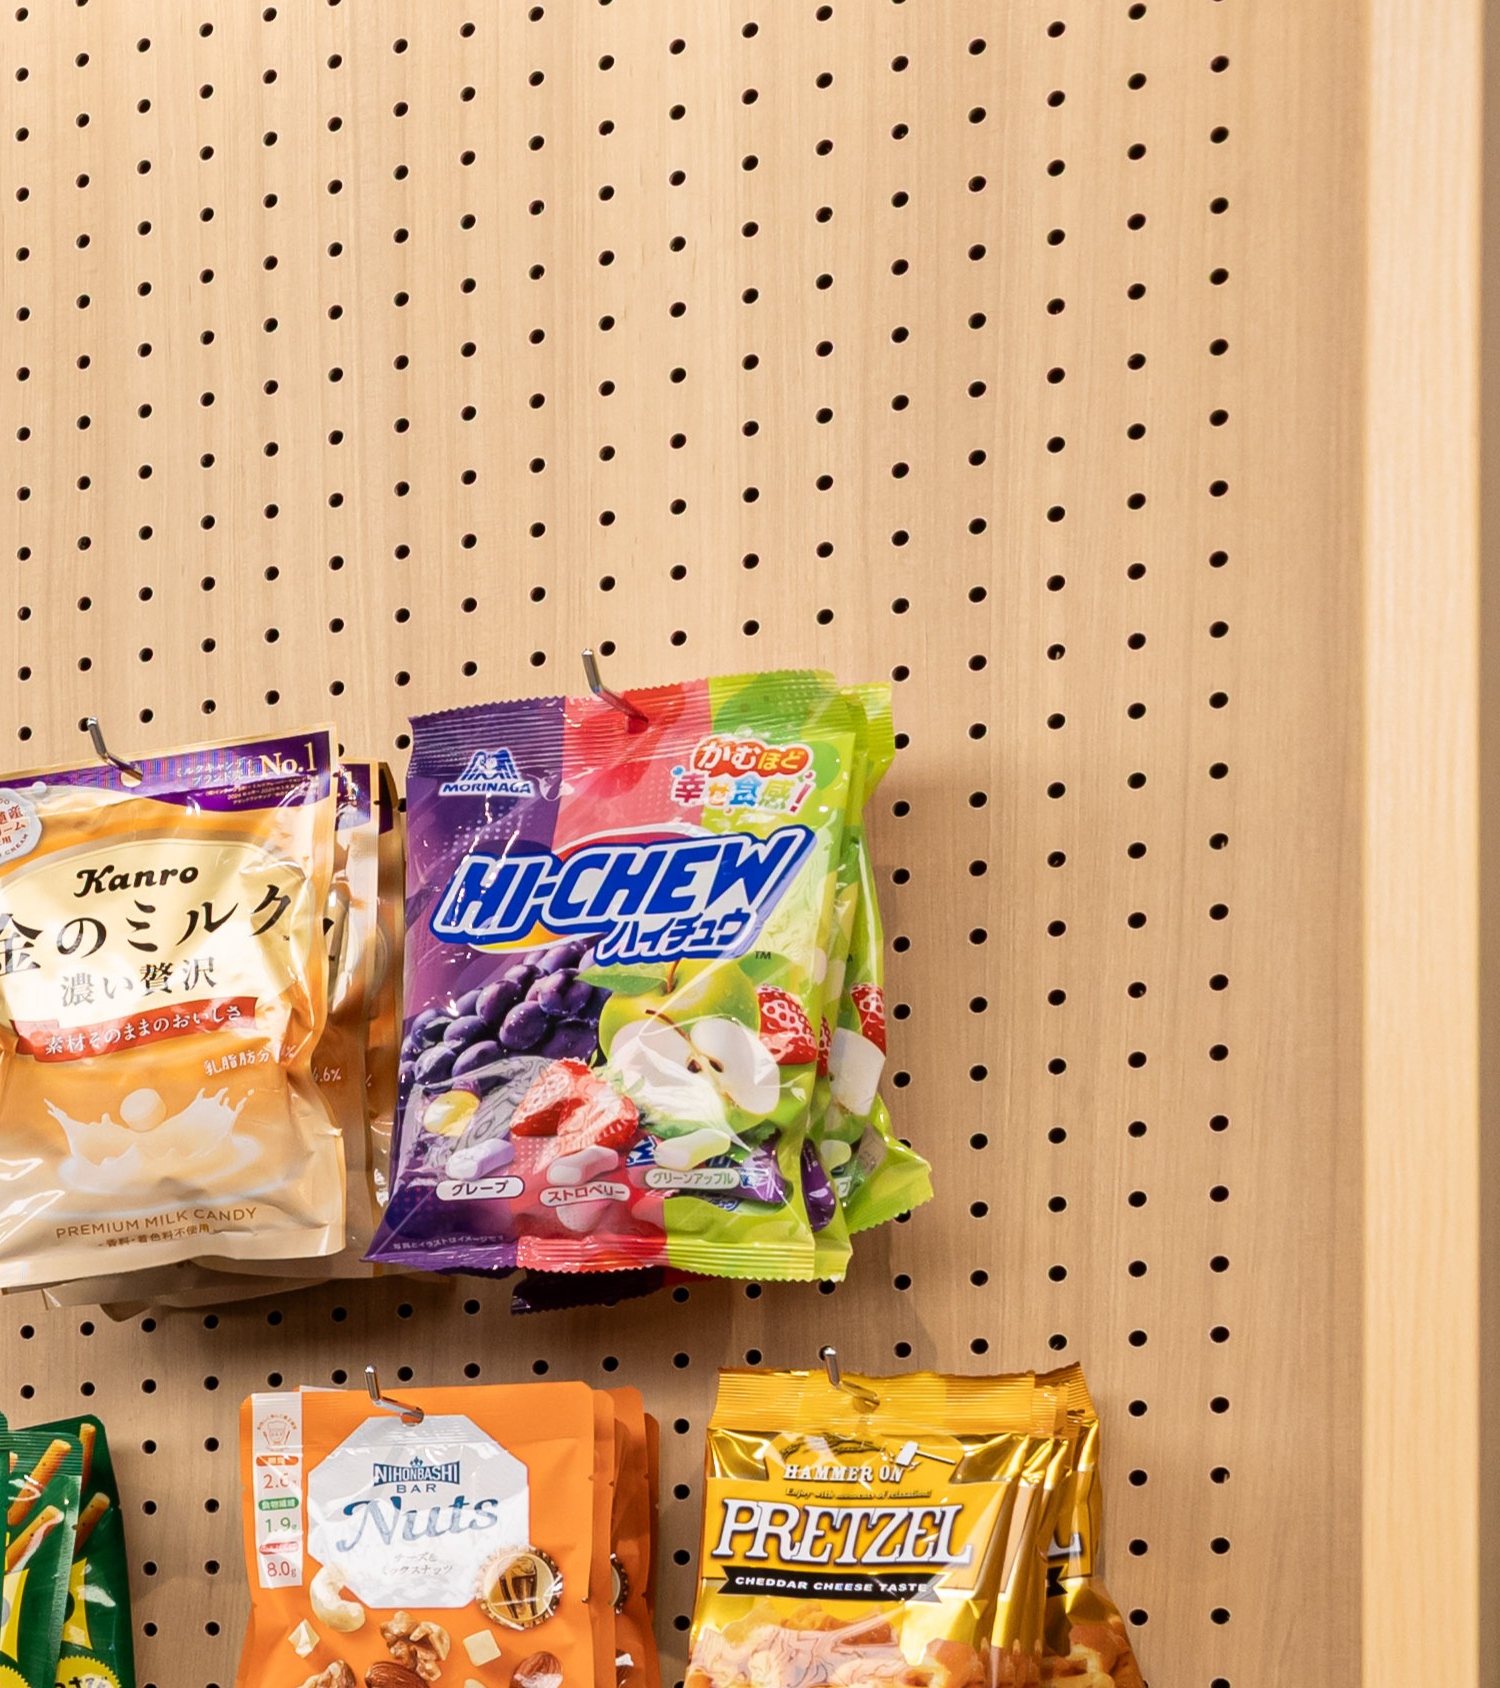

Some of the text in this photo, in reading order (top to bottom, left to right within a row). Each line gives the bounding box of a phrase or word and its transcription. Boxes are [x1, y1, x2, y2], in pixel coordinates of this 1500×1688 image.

[260, 742, 318, 778] No.1
[699, 740, 807, 773] かむほど
[443, 780, 531, 795] MORINAGA
[674, 774, 809, 813] 幸せ食感!
[73, 864, 199, 898] Kanro
[441, 828, 806, 936] HI-CHEW
[598, 908, 758, 960] ハイチュウ
[60, 955, 218, 1008] 濃い贅沢
[44, 1004, 243, 1057] 素材そのままのおいしさ
[203, 1048, 272, 1077] 乳脂肪分
[451, 1181, 508, 1197] グレープ
[547, 1185, 626, 1205] ストロベリー
[652, 1172, 735, 1187] グリーンアップル
[56, 1206, 258, 1239] PREMIUM MILK CANDY
[374, 1461, 460, 1485] NIHONBASHI
[396, 1483, 436, 1493] BAR
[783, 1463, 903, 1484] HAMMER ON
[336, 1494, 500, 1552] Nuts
[710, 1499, 974, 1566] PRETZEL
[267, 1561, 297, 1577] 8.0g
[734, 1576, 927, 1593] CHEDDAR CHEESE TASTE
